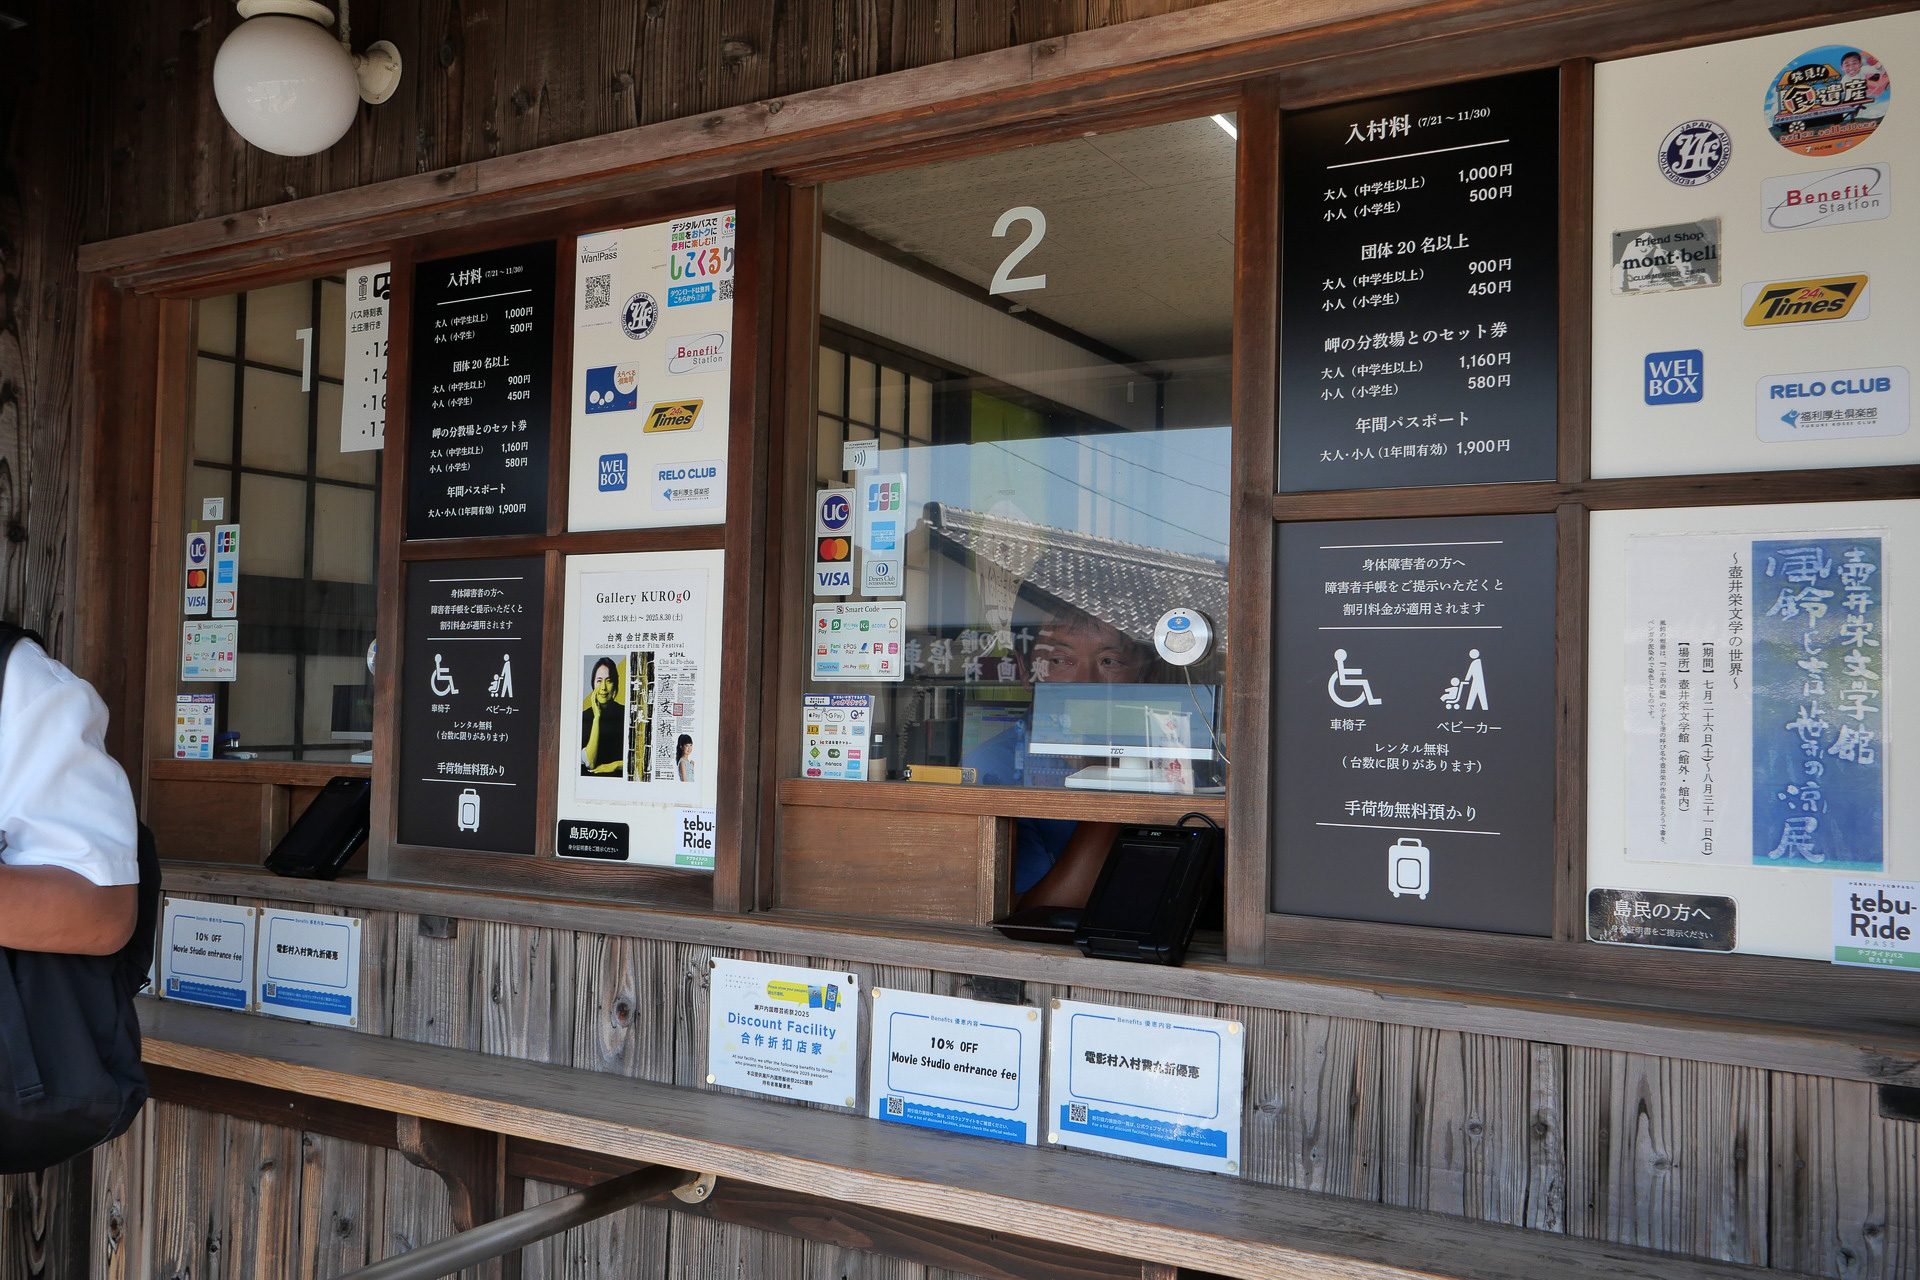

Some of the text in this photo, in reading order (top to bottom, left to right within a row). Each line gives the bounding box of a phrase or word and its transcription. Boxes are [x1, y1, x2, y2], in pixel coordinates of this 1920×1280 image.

[1791, 66, 1826, 83] 発見!!
[1345, 114, 1412, 145] 入村料
[1681, 122, 1712, 132] JAPAN
[1660, 132, 1731, 185] AUTOMOBILE FEDERATION
[1458, 163, 1513, 184] 1,000円
[1469, 185, 1513, 203] 500円
[1787, 184, 1870, 207] Benefit
[1819, 198, 1880, 214] Station
[672, 218, 717, 232] デジタルパスで
[672, 227, 717, 242] 四国をおトクに
[1635, 232, 1704, 247] Friend Shop
[581, 251, 617, 263] Wan!Pass
[989, 206, 1046, 295] 2
[671, 246, 734, 280] しこくるり
[1468, 258, 1512, 275] 900円
[447, 268, 482, 288] 入村料
[1633, 271, 1681, 282] CLUB MEMBER
[1468, 280, 1512, 296] 450円
[1798, 288, 1824, 300] 24h
[350, 307, 383, 319] バス時刻表
[505, 306, 533, 319] 1,000円
[1764, 297, 1847, 319] Times
[351, 320, 381, 333] 土庄港行き
[510, 322, 533, 334] 500円
[1324, 321, 1508, 353] 岬の分教場とのセット券
[678, 346, 719, 358] Benefit
[296, 328, 312, 392] 1
[693, 355, 723, 365] Station
[1459, 352, 1511, 370] 1,160円
[1649, 359, 1699, 379] WEL
[508, 374, 531, 385] 900円
[1468, 374, 1511, 390] 580円
[1649, 376, 1698, 397] BOX
[508, 390, 530, 401] 450円
[1770, 377, 1891, 400] RELO CLUB
[653, 414, 693, 428] Times
[1800, 407, 1878, 422] 福利厚生倶楽部
[432, 420, 527, 439] 岬の分教場とのセット券
[1355, 411, 1469, 434] 年間パスポート
[502, 442, 528, 453] 1,160円
[1457, 439, 1510, 456] 1,900円
[506, 458, 528, 467] 580円
[601, 460, 626, 473] WEL
[600, 472, 625, 486] BOX
[659, 467, 716, 481] RELO CLUB
[447, 483, 506, 498] 年間パスポート
[499, 504, 526, 515] 1,900円
[1363, 557, 1465, 572] 身体障害者の方へ
[817, 572, 850, 586] VISA
[1325, 579, 1504, 594] 障害者手帳をご提示いただくと
[451, 588, 504, 598] 身体障害者の方へ
[596, 590, 691, 604] Gallery KUROgO
[187, 596, 206, 607] VISA
[1343, 602, 1485, 616] 割引料金が適用されます
[431, 605, 523, 615] 障害者手帳をご提示いただくと
[440, 621, 513, 630] 割引料金が適用されます
[431, 704, 451, 713] 車椅子
[486, 706, 519, 715] ベビーカー
[454, 721, 493, 731] レンタル無料
[1330, 719, 1366, 731] 車椅子
[1437, 721, 1502, 734] ベビーカー
[1375, 743, 1449, 756] レンタル無料
[437, 762, 505, 777] 手荷物無料預かり
[1342, 756, 1483, 774] (台数に限りがあります)
[1345, 800, 1476, 822] 手荷物無料預かり
[684, 815, 715, 832] tebu-
[570, 827, 618, 841] 島民の方へ
[684, 832, 711, 849] Ride
[1850, 890, 1917, 915] tebu-
[1614, 900, 1711, 921] 島民の方へ
[1851, 913, 1911, 941] Ride
[195, 932, 222, 943] 10% OFF
[1865, 940, 1896, 948] PASS
[173, 944, 242, 961] Movie Studio entrance fee
[1858, 950, 1904, 958] テブライドパス
[728, 1012, 836, 1040] Discount Facility
[931, 1015, 953, 1024] Benefits
[1118, 1017, 1143, 1026] Benefits
[741, 1032, 822, 1055] 合作折扣店家
[931, 1037, 978, 1053] 10% OFF
[892, 1052, 1017, 1080] Movie Studio entrance fee
